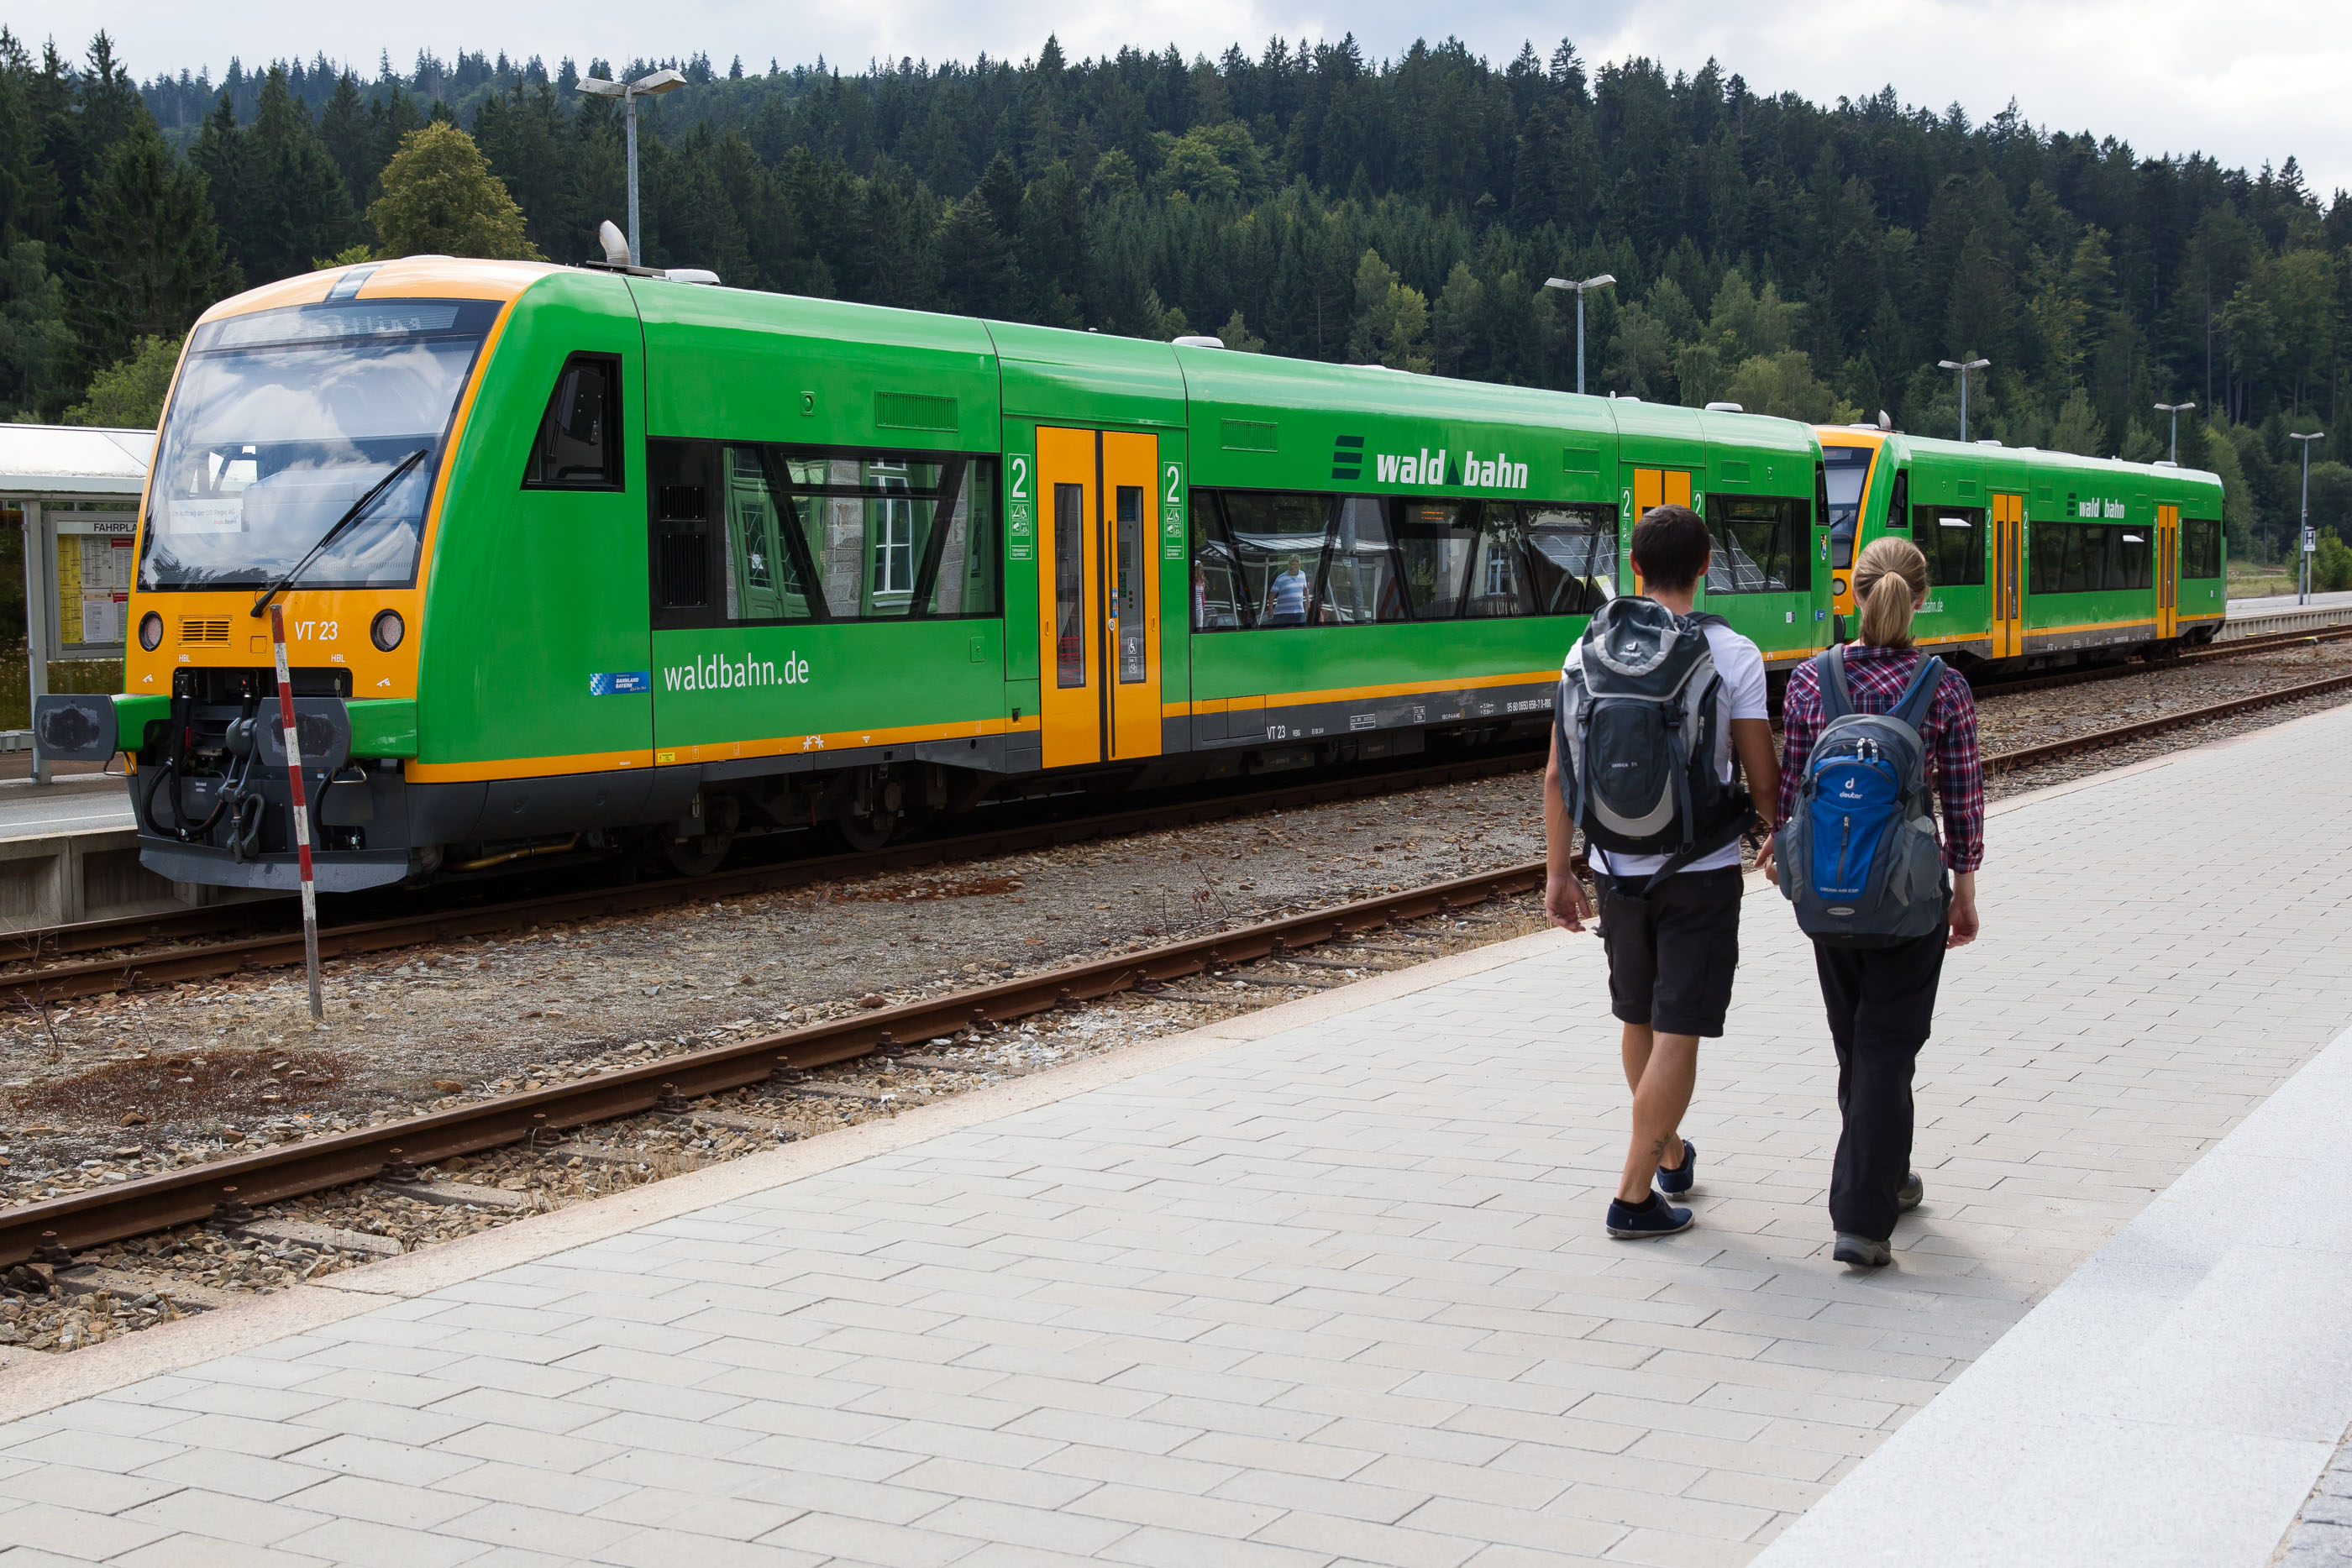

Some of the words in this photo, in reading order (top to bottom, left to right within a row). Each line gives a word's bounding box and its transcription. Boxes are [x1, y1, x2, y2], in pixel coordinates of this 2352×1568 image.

[1012, 458, 1026, 497] 2
[1377, 448, 1446, 485] wald
[1463, 450, 1528, 489] bahn
[1167, 465, 1179, 502] 2
[1623, 490, 1630, 517] 2
[1695, 493, 1701, 517] 2
[2079, 497, 2100, 517] wald
[2104, 498, 2124, 518] bahn
[1987, 508, 1992, 527] 2
[2024, 511, 2028, 529] 2
[2306, 532, 2313, 544] H
[295, 621, 316, 640] VT
[319, 621, 338, 640] 23
[331, 654, 345, 663] HBL
[664, 650, 809, 691] waldbahn.de
[1266, 726, 1276, 739] VT
[1277, 725, 1286, 739] 23
[1840, 790, 1863, 799] deuter
